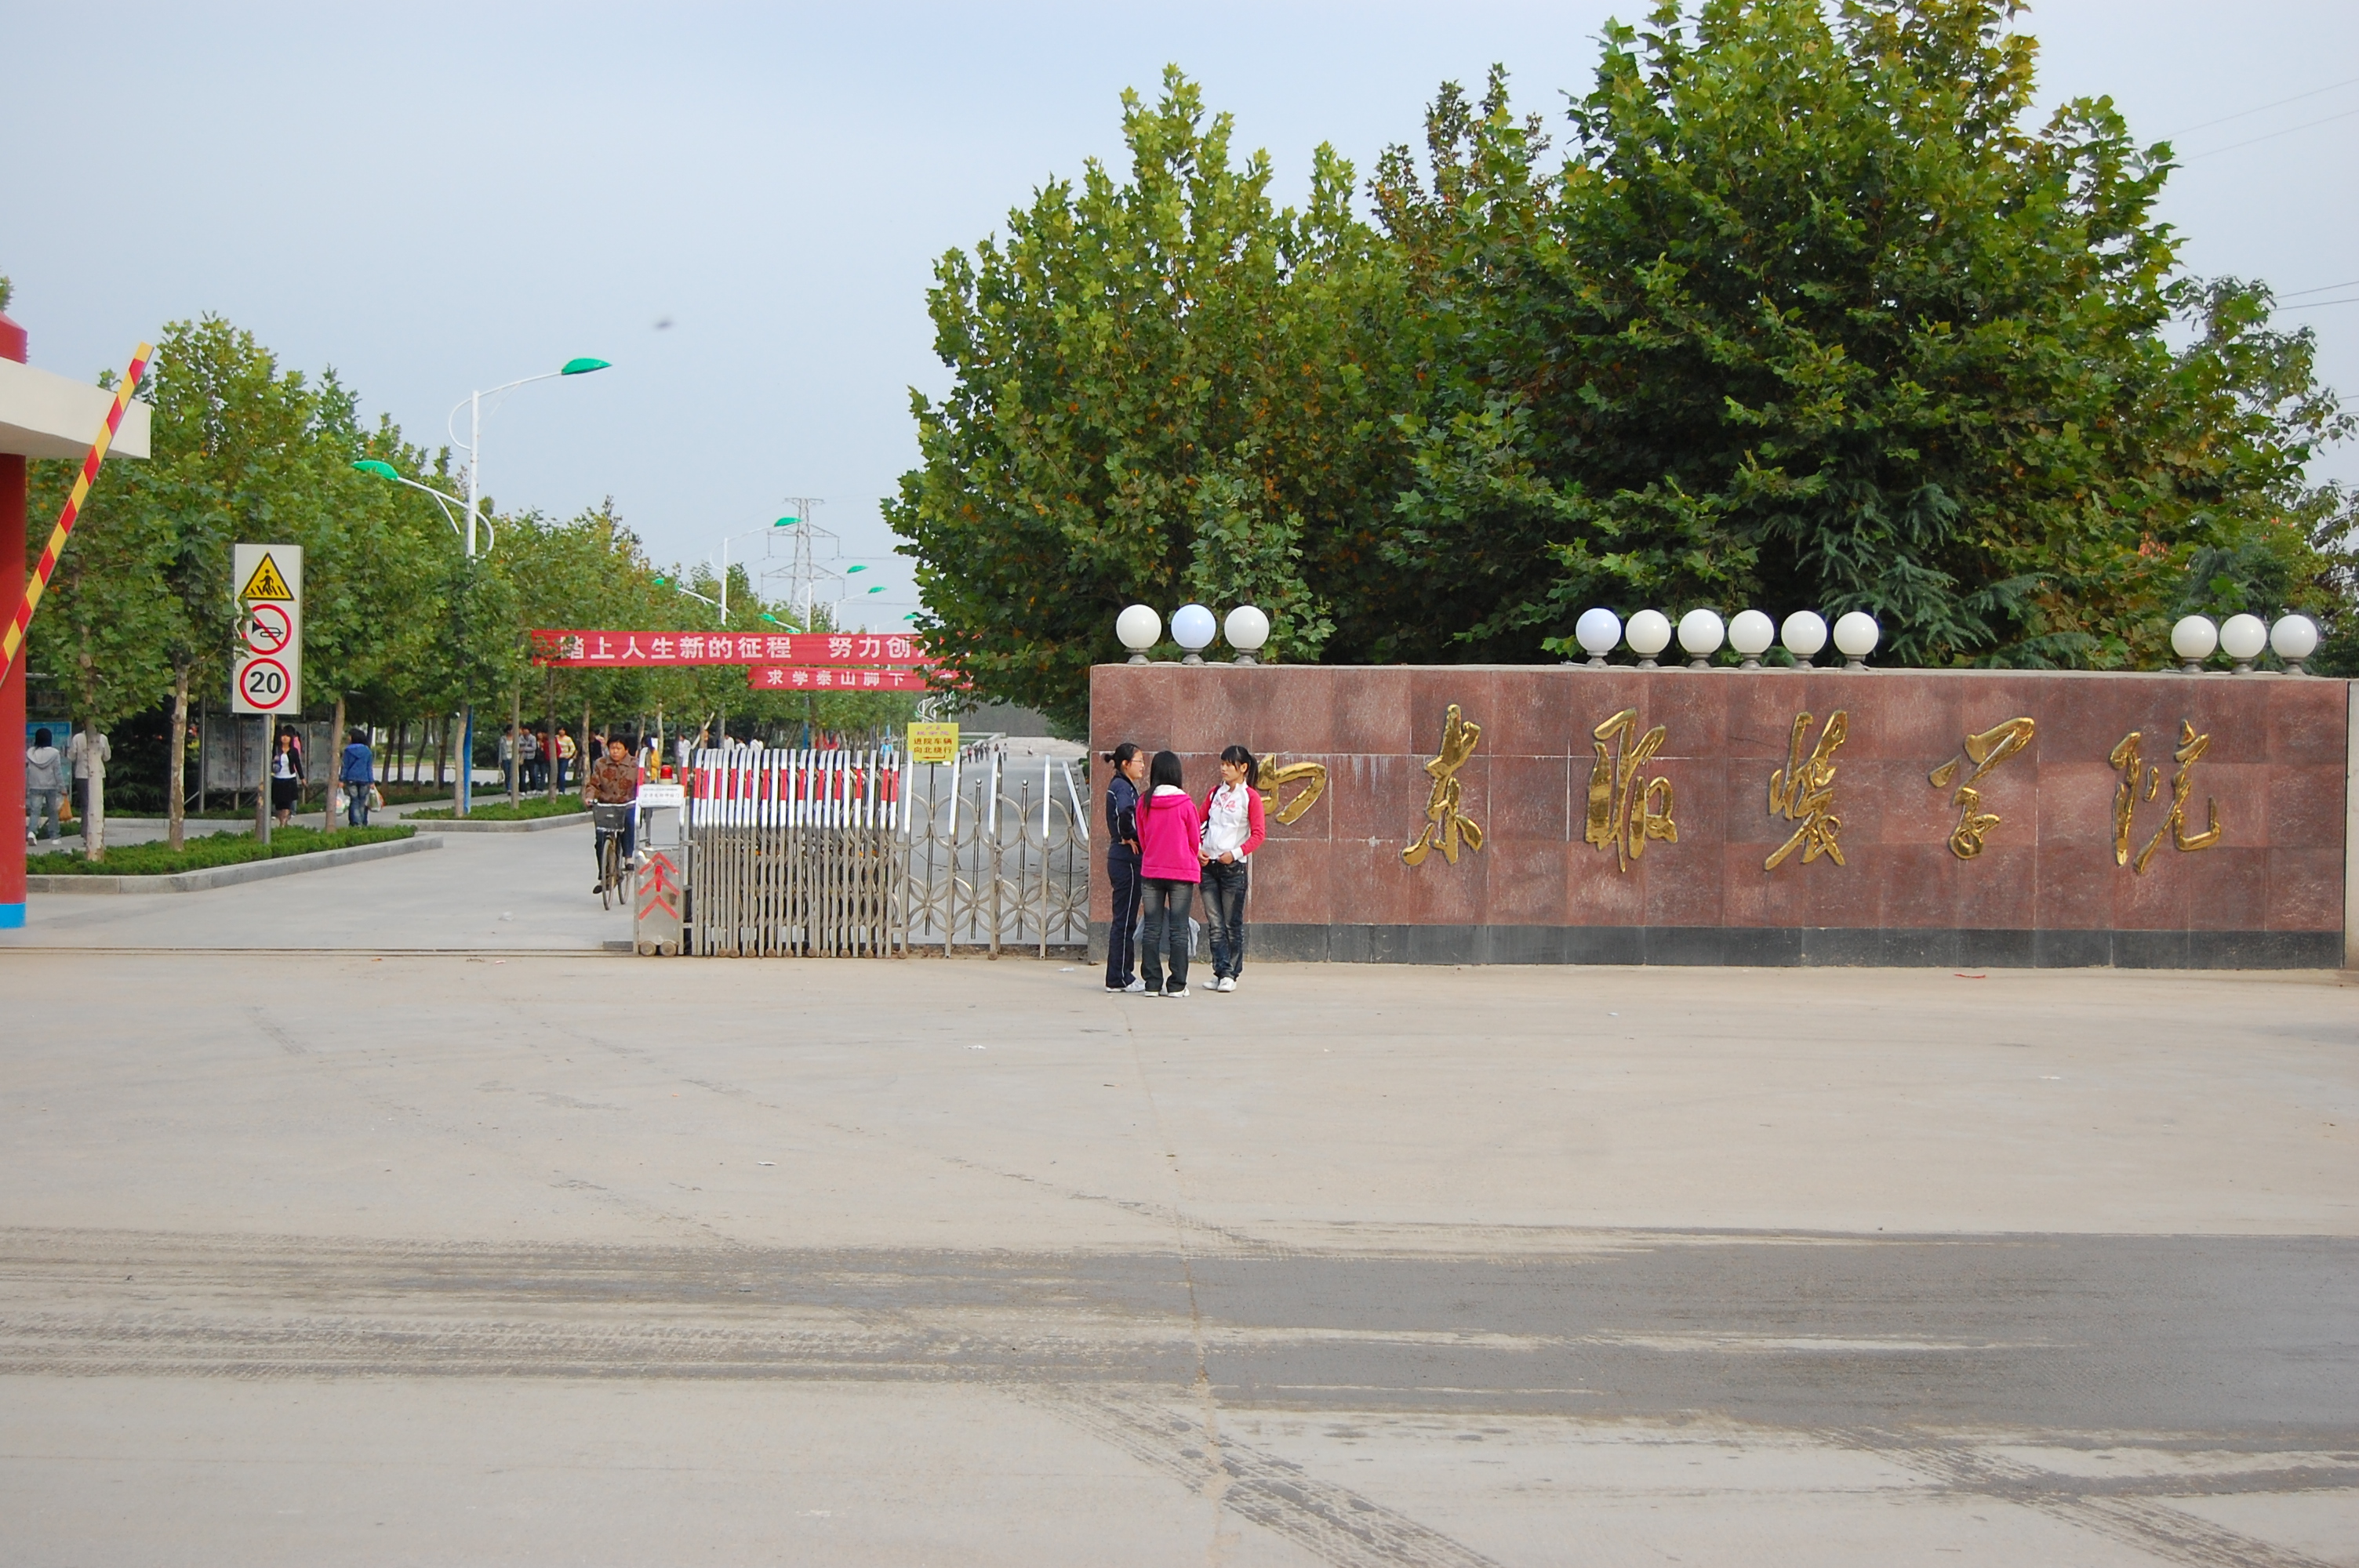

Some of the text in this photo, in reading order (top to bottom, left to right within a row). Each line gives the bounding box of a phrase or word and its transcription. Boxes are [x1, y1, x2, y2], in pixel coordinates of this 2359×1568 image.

[828, 636, 931, 659] 努力创
[249, 671, 282, 694] 20
[767, 670, 905, 686] 求学泰山脚下
